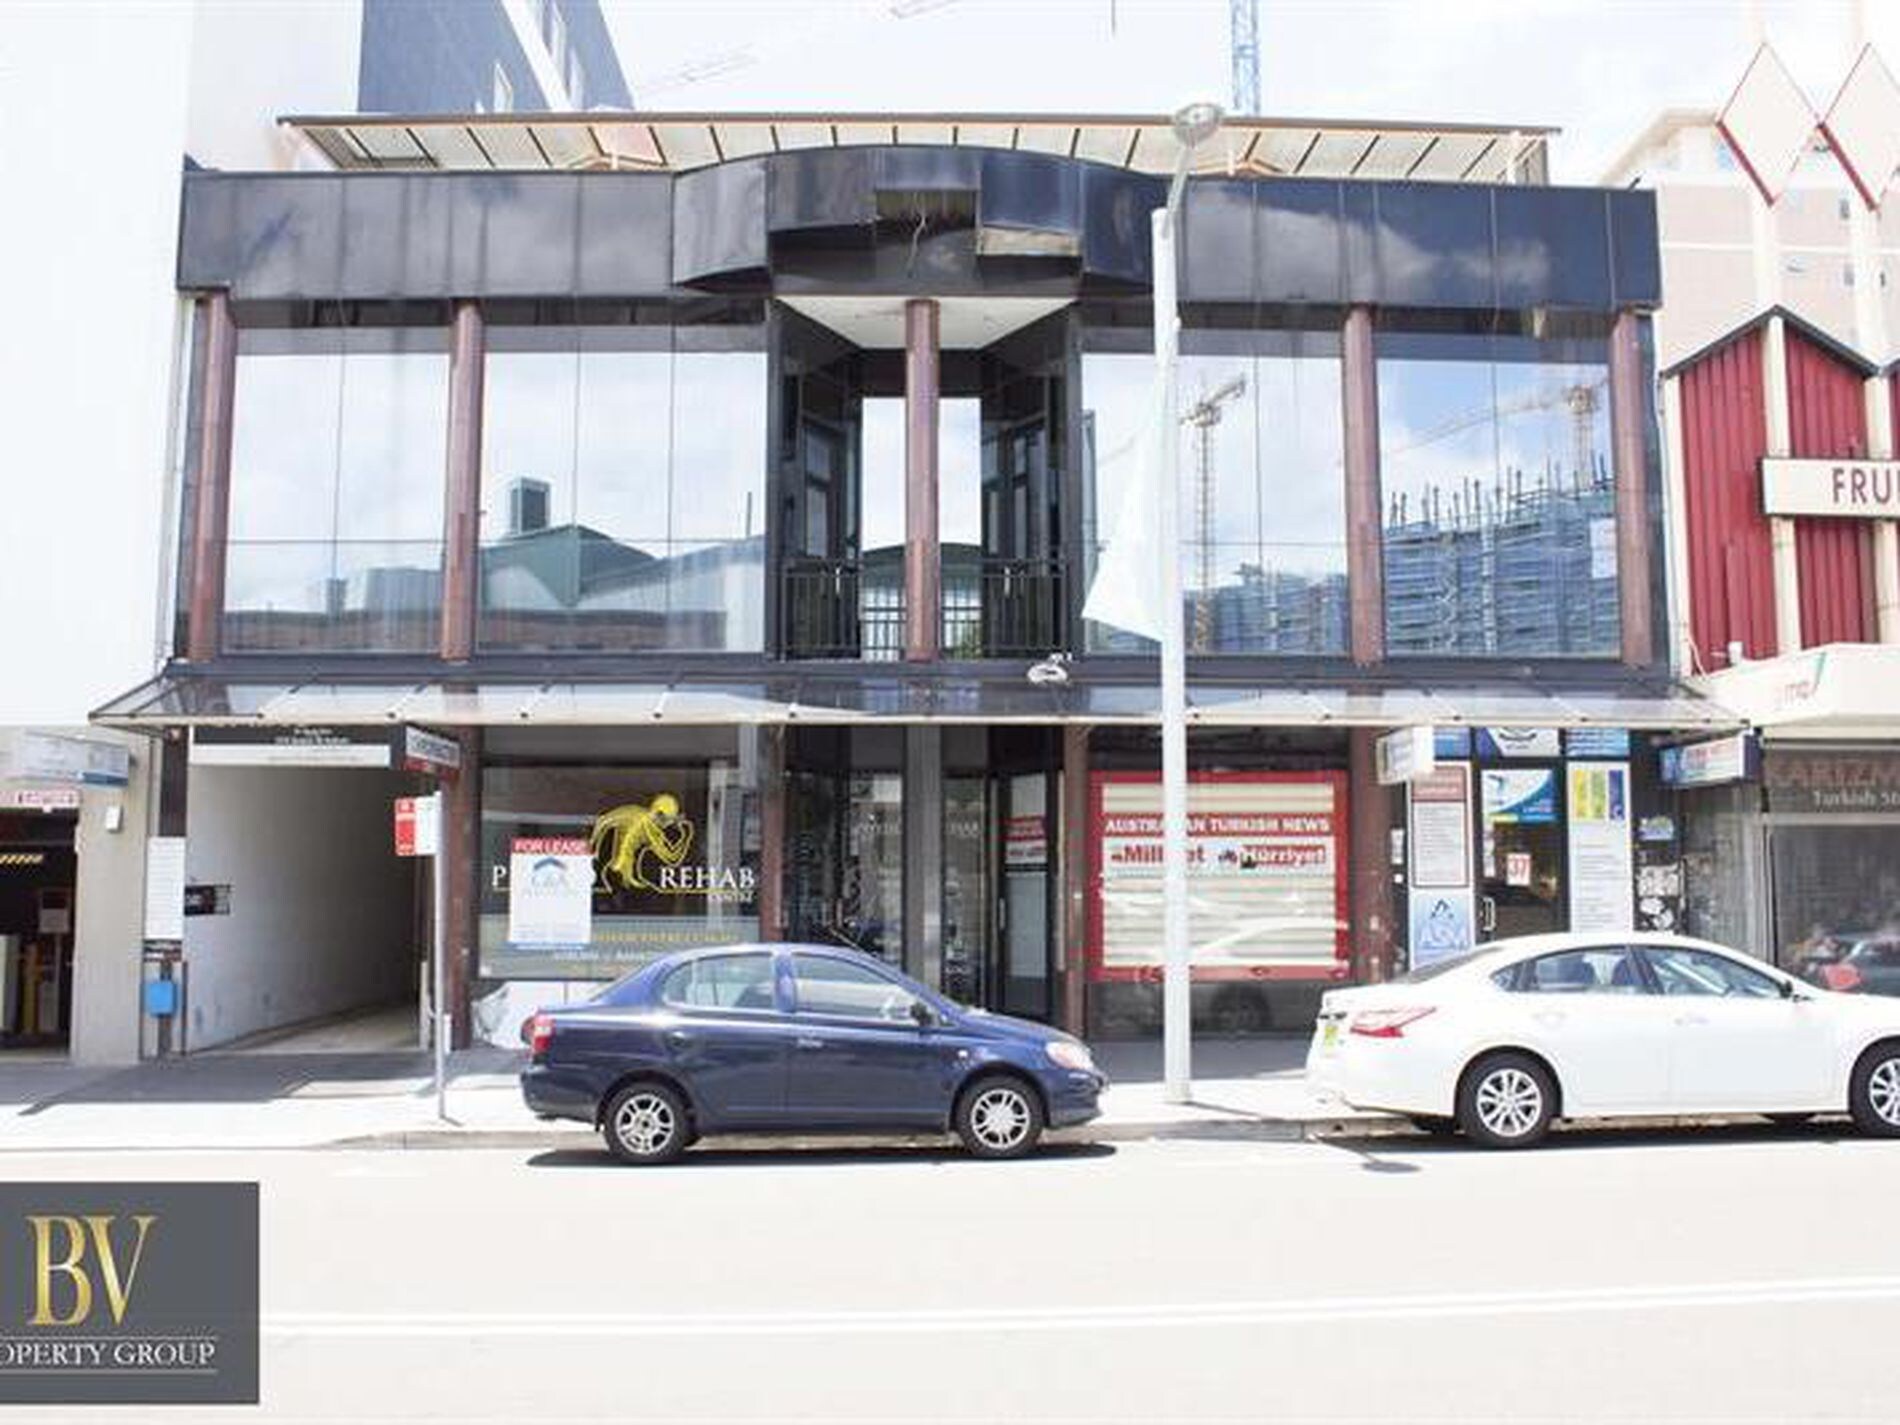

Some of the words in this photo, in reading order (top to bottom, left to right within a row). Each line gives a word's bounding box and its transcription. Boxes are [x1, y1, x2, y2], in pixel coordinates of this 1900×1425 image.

[1105, 818, 1206, 832] AUSTRAAN
[1211, 818, 1277, 832] TURKISH
[1282, 817, 1330, 832] NEWS
[514, 840, 543, 852] FOR
[1124, 846, 1205, 862] Millet
[660, 866, 755, 889] REHAB
